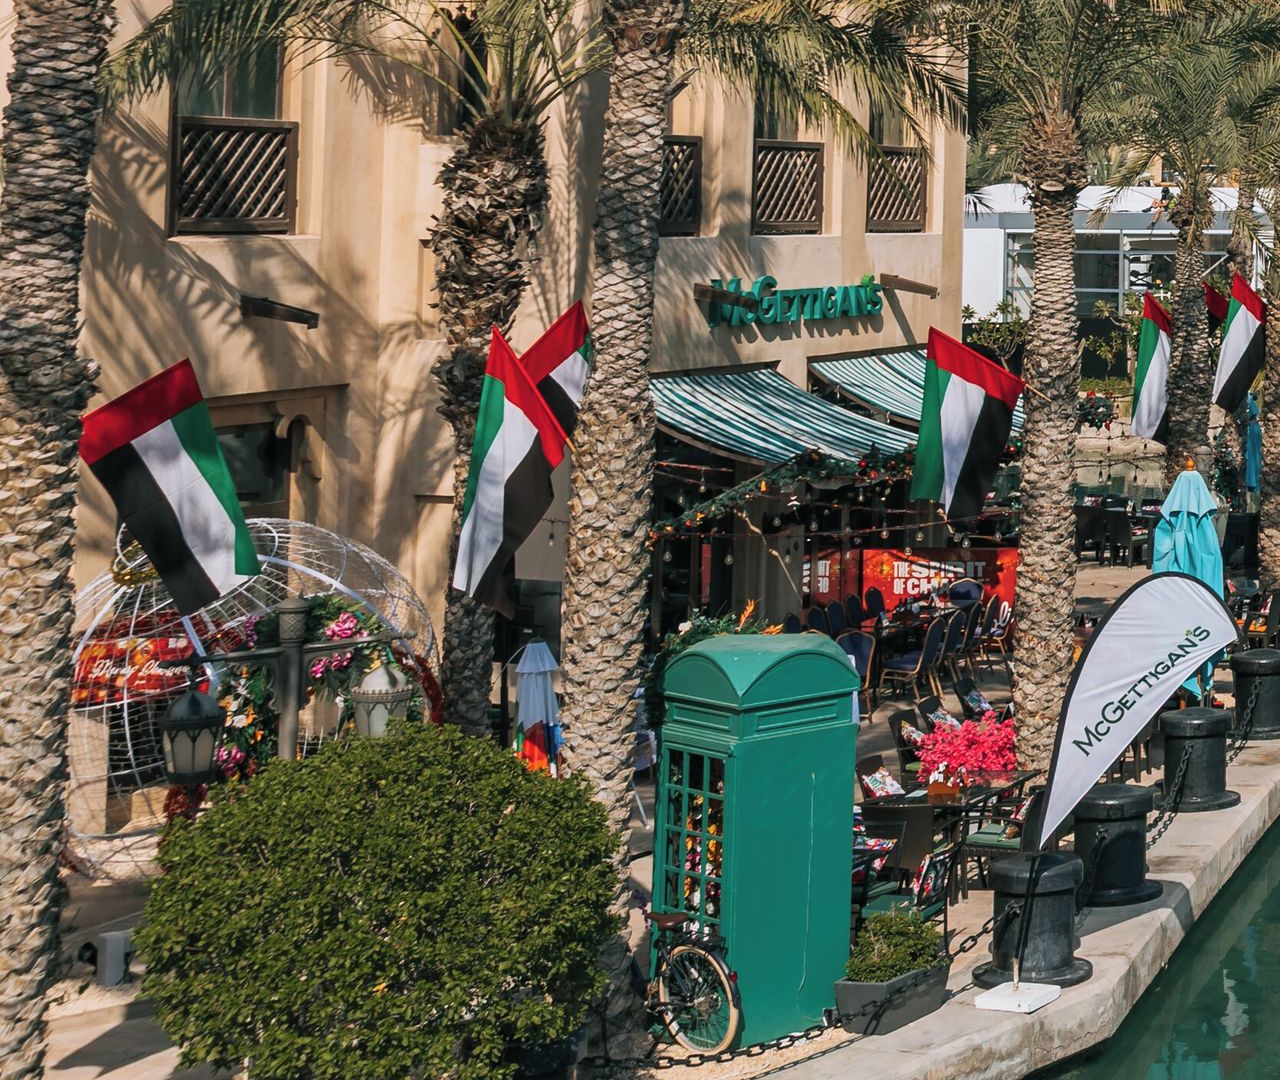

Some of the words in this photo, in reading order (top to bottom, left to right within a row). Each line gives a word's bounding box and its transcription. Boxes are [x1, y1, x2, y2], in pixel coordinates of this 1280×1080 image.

[893, 561, 910, 578] THE
[911, 561, 986, 578] SPIRIT
[893, 578, 906, 595] OF
